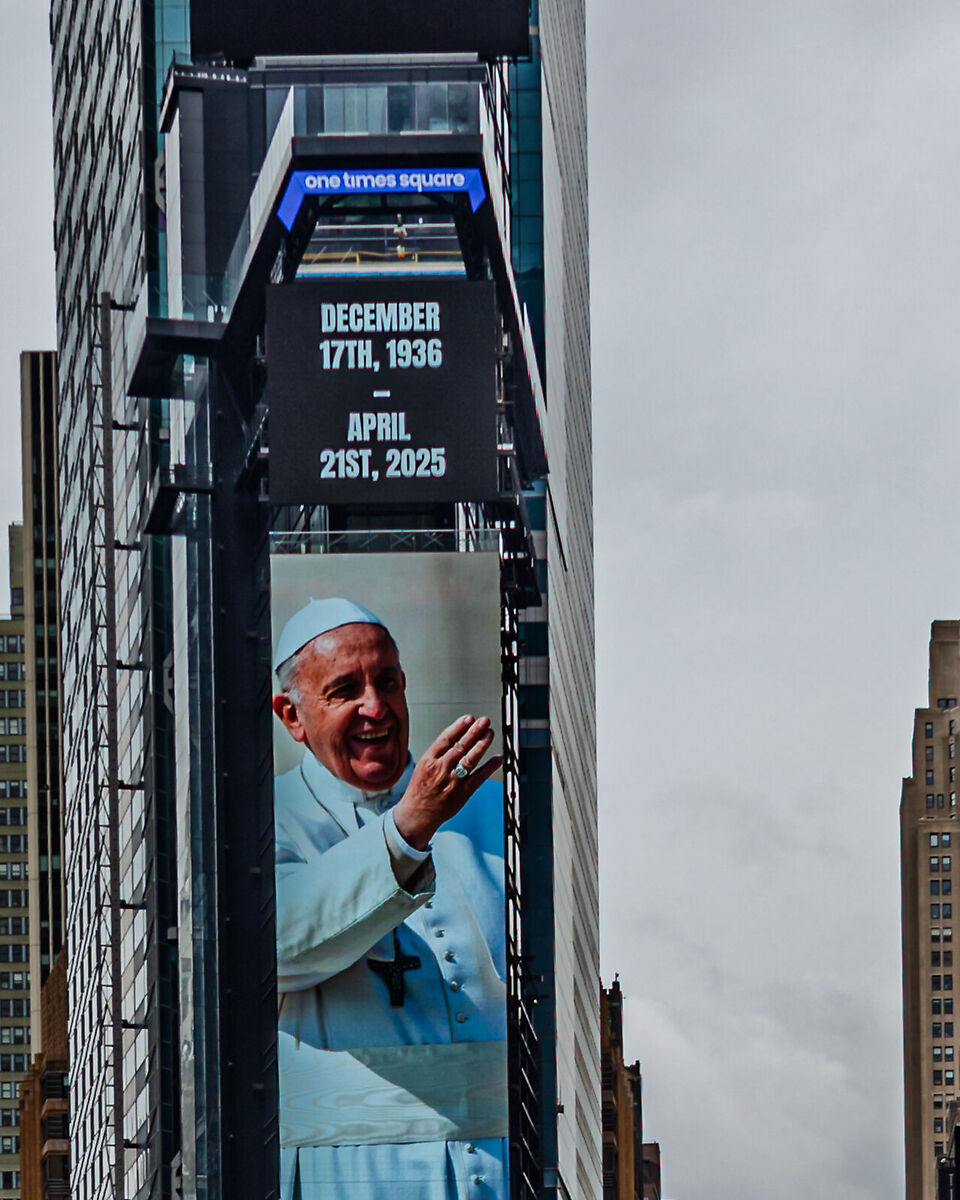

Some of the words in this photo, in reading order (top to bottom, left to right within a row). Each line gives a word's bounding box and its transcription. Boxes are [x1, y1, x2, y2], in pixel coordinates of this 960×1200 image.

[305, 174, 341, 189] one
[343, 171, 397, 189] times
[399, 172, 466, 192] square
[320, 301, 441, 333] DECEMBER
[319, 338, 381, 372] 17TH,
[385, 337, 443, 369] 1936
[347, 412, 412, 442] APRIL
[320, 448, 380, 482] 21ST,
[385, 447, 447, 478] 2025
